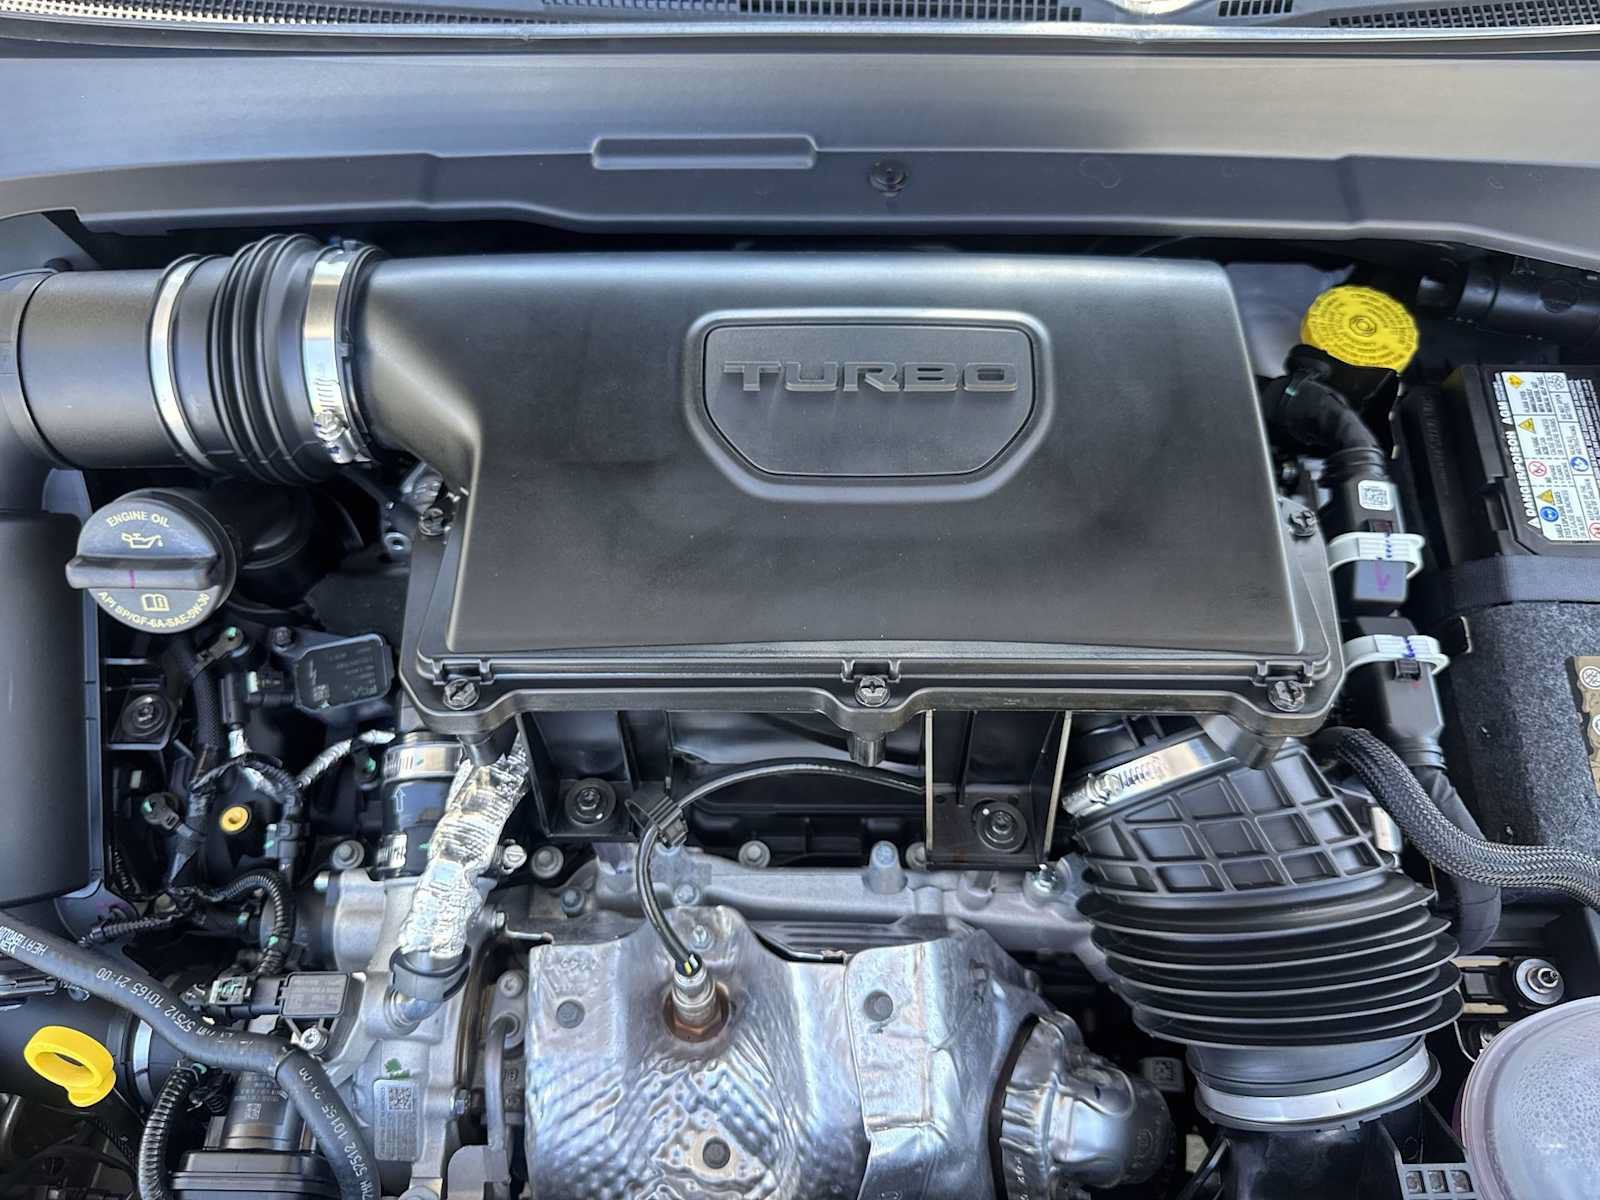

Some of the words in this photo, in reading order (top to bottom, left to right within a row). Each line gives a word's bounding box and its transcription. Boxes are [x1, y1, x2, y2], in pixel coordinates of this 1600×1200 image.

[722, 360, 1018, 393] TURBO
[1497, 401, 1512, 424] AGM
[1505, 430, 1535, 516] DANGER/POISON
[106, 511, 148, 528] ENGINE
[151, 513, 170, 528] OIL
[97, 591, 114, 609] API
[130, 982, 165, 1009] 10165
[164, 1004, 196, 1033] 57512
[344, 1142, 368, 1177] 57512
